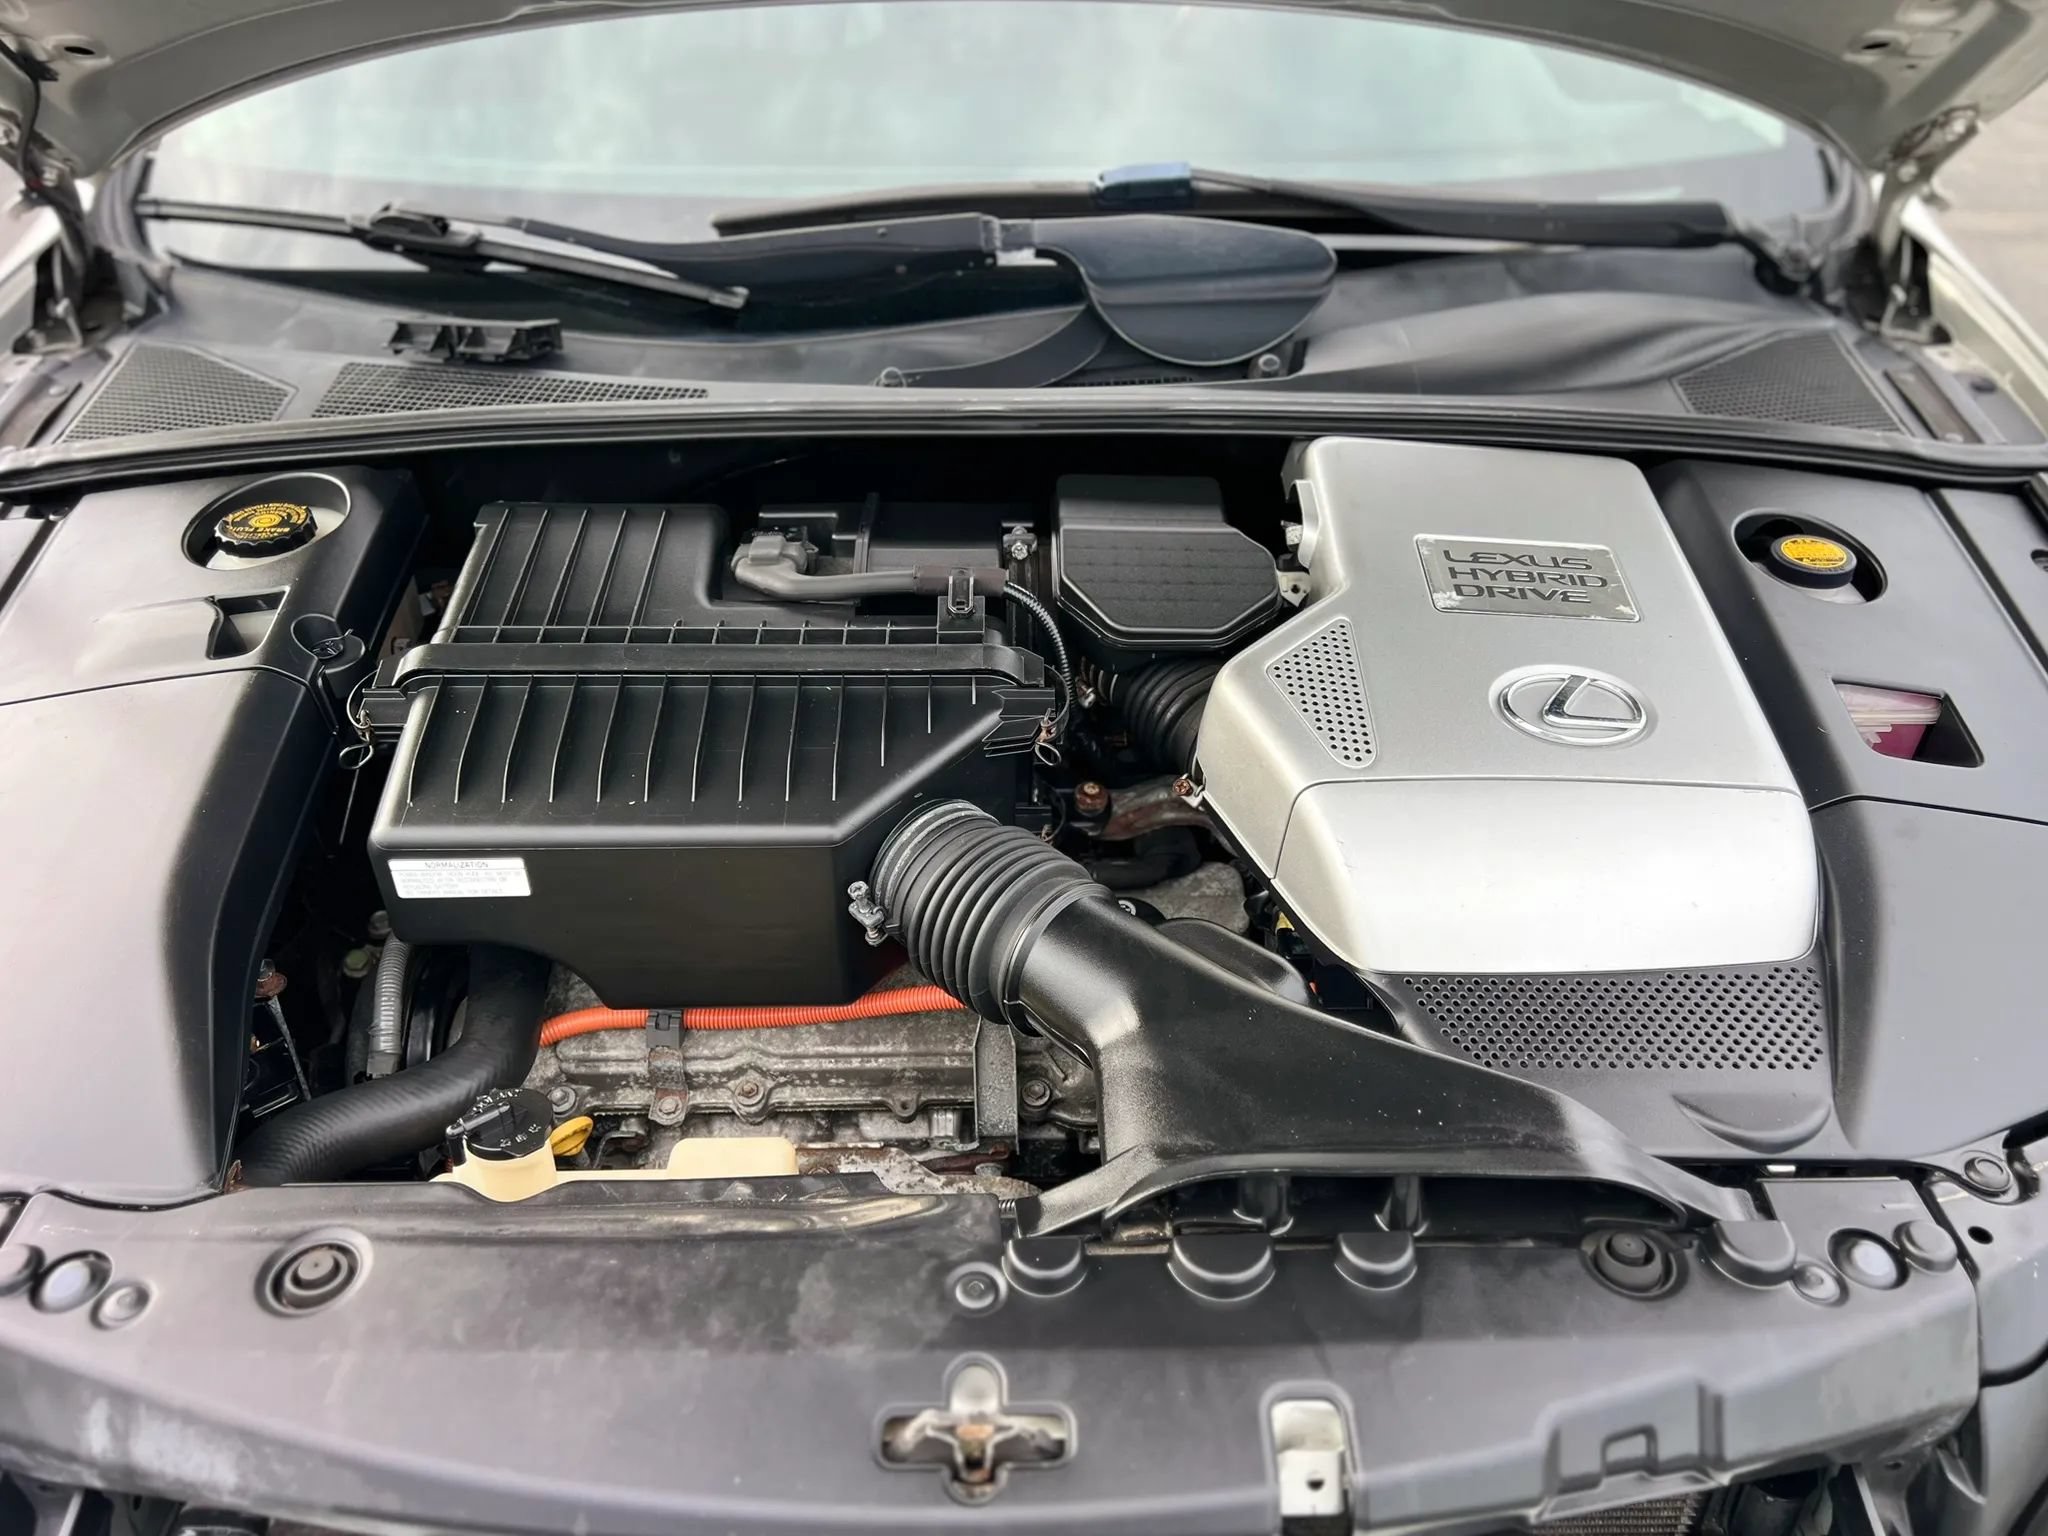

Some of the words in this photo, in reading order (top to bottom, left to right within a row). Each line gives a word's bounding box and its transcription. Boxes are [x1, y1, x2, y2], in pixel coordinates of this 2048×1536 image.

[1443, 549, 1593, 570] LEXUS
[1447, 566, 1608, 588] HYBRID
[1453, 584, 1592, 604] DRIVE
[424, 861, 489, 869] NORMALIZATION
